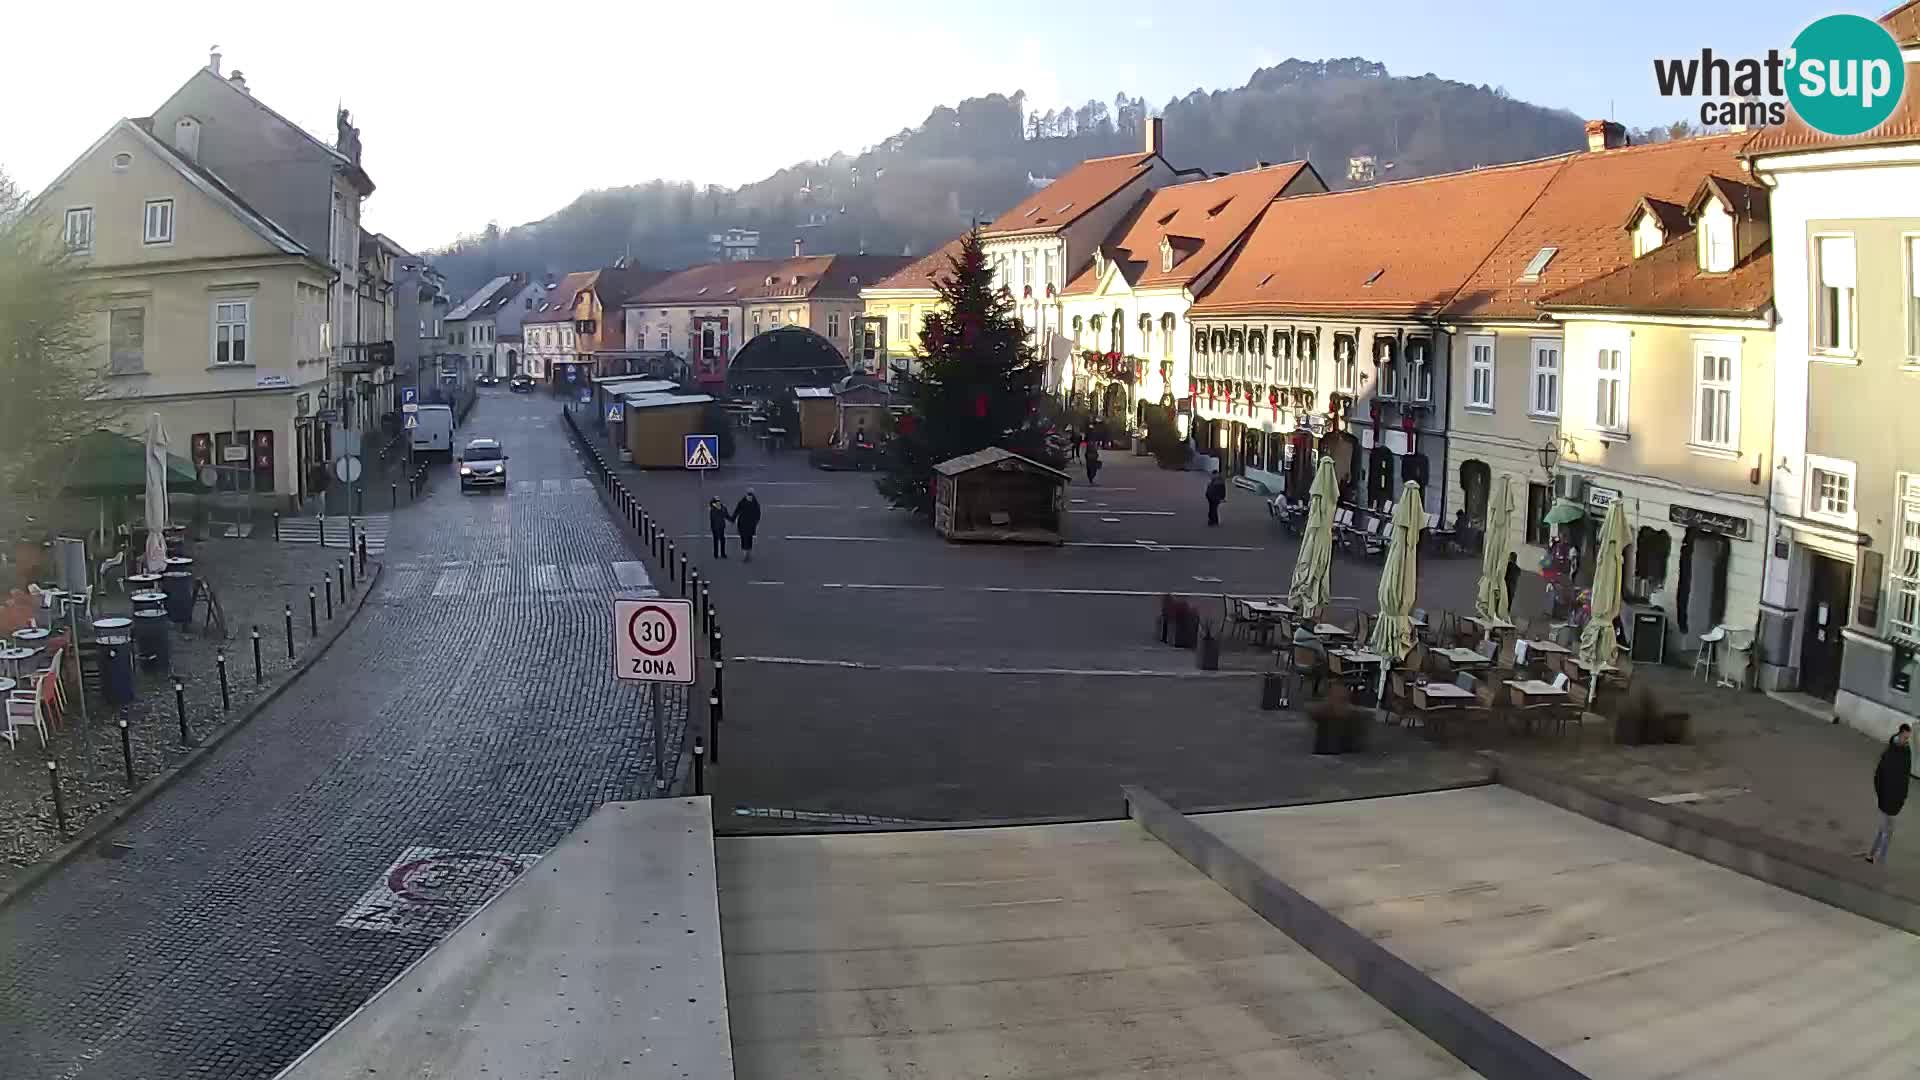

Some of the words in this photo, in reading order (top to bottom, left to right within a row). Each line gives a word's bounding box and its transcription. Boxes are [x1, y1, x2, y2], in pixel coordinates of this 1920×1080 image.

[406, 390, 414, 402] P
[641, 621, 666, 643] 30
[631, 658, 676, 676] ZONA
